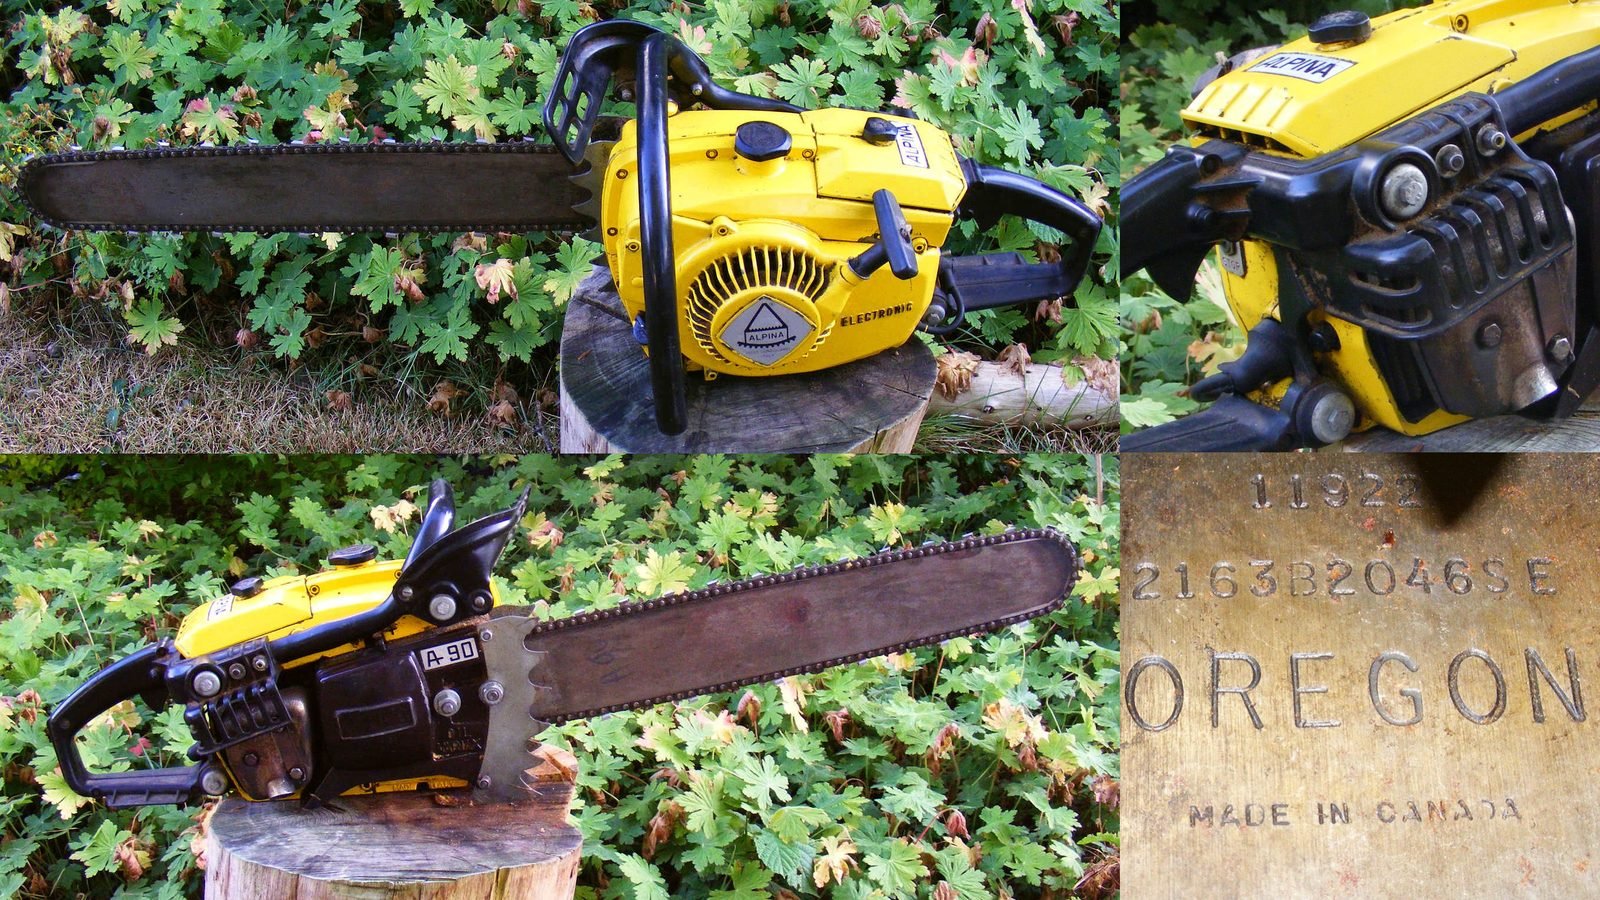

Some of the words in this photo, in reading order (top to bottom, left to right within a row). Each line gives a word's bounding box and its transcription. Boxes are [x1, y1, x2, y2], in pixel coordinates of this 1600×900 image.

[1257, 56, 1337, 78] ALPINA
[897, 125, 921, 165] ALPINA
[840, 302, 913, 327] ELECTRONIC
[749, 331, 785, 341] ALPINA
[1250, 472, 1423, 509] 11922
[1124, 647, 1587, 732] OREGON
[1189, 802, 1291, 828] MADE
[1317, 802, 1352, 825] IN
[1375, 798, 1523, 824] CANADA
